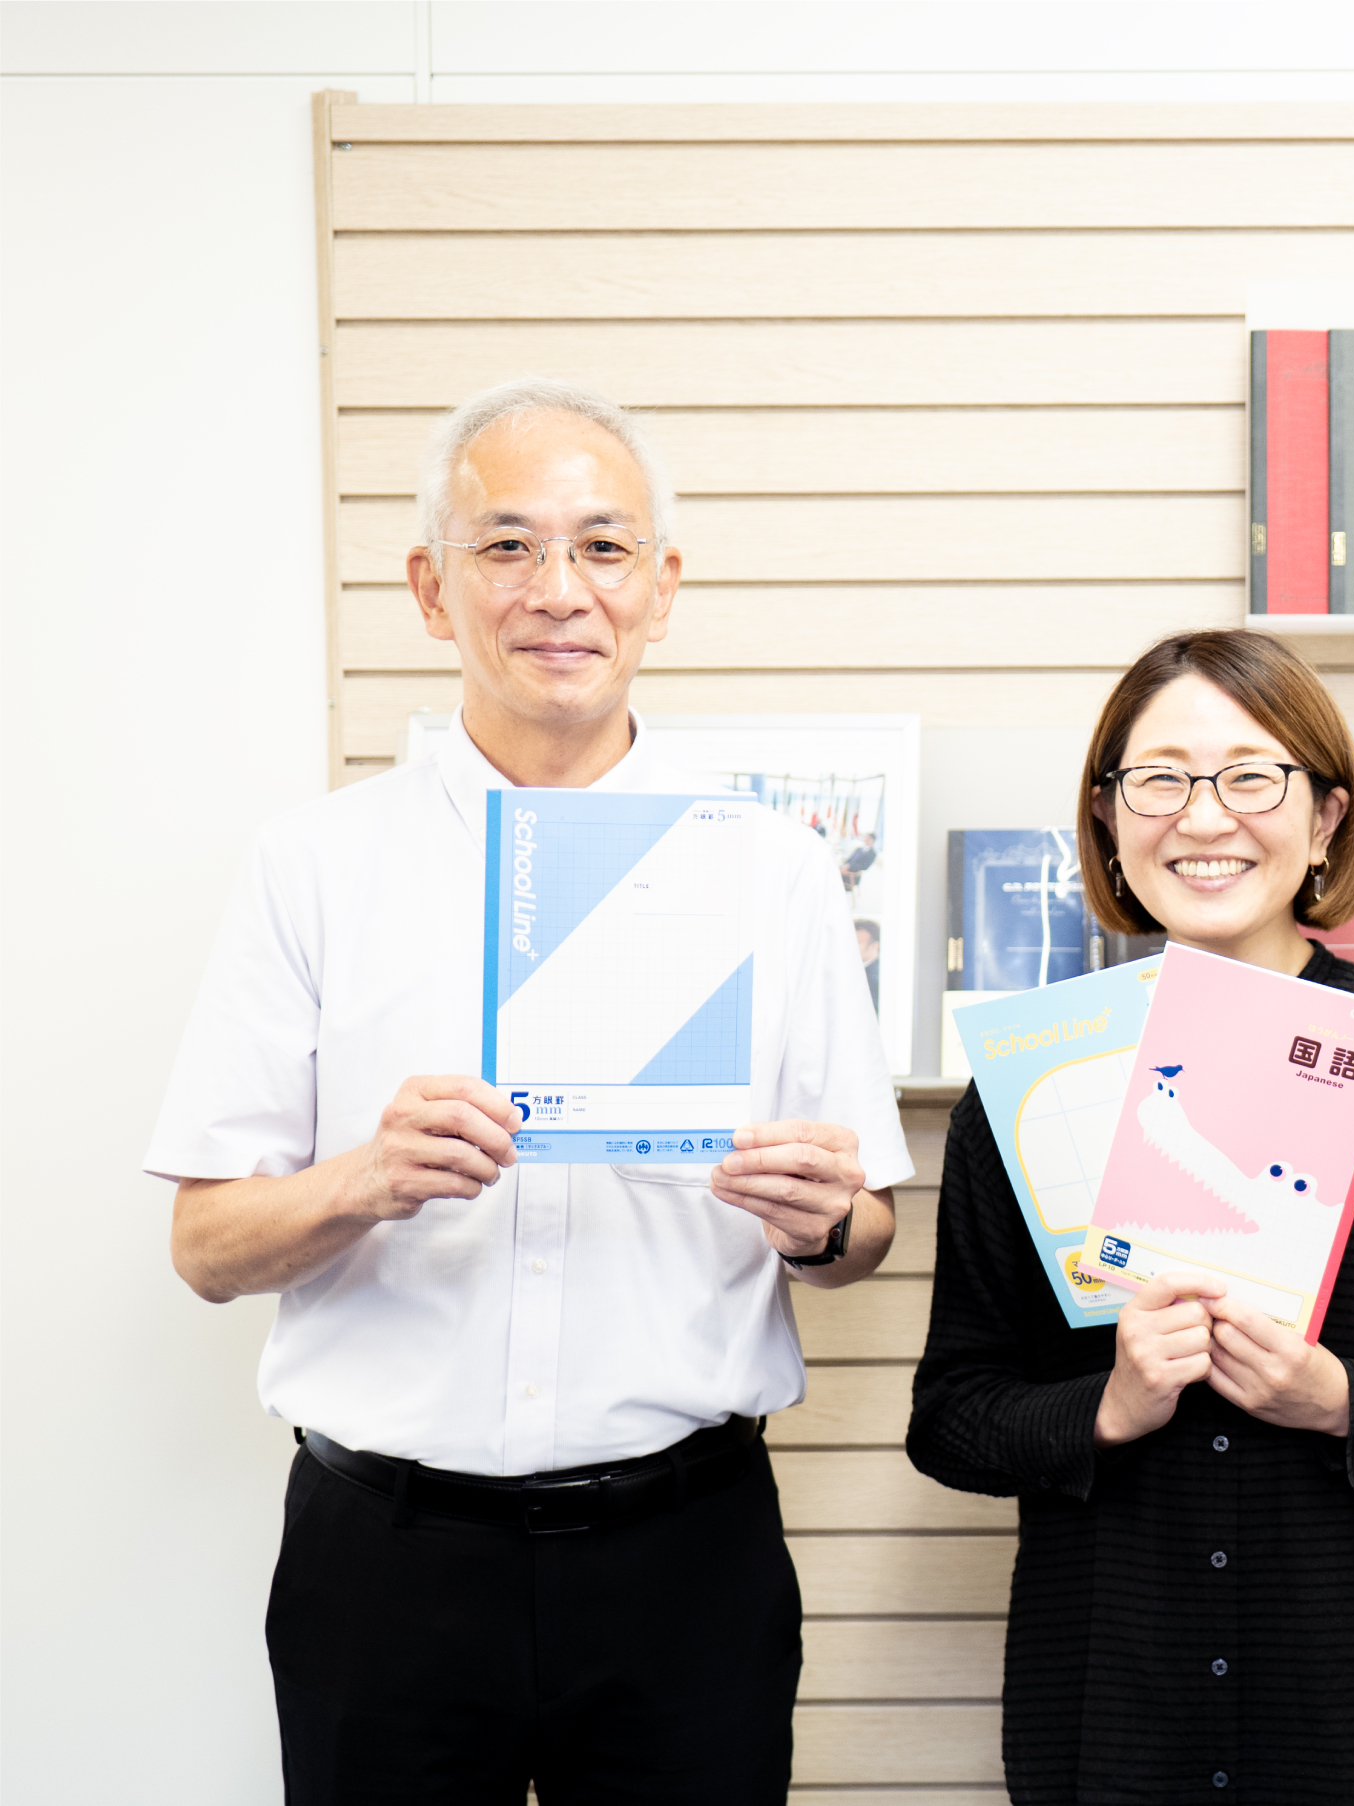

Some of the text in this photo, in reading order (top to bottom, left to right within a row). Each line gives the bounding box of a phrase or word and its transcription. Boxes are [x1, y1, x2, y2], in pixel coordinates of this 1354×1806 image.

[513, 807, 538, 899] School
[984, 1022, 1060, 1059] School
[1295, 1070, 1344, 1089] Japanese
[532, 1095, 565, 1105] 方眼罫
[536, 1106, 562, 1115] mm
[1102, 1237, 1118, 1255] 5
[1115, 1252, 1128, 1260] mm
